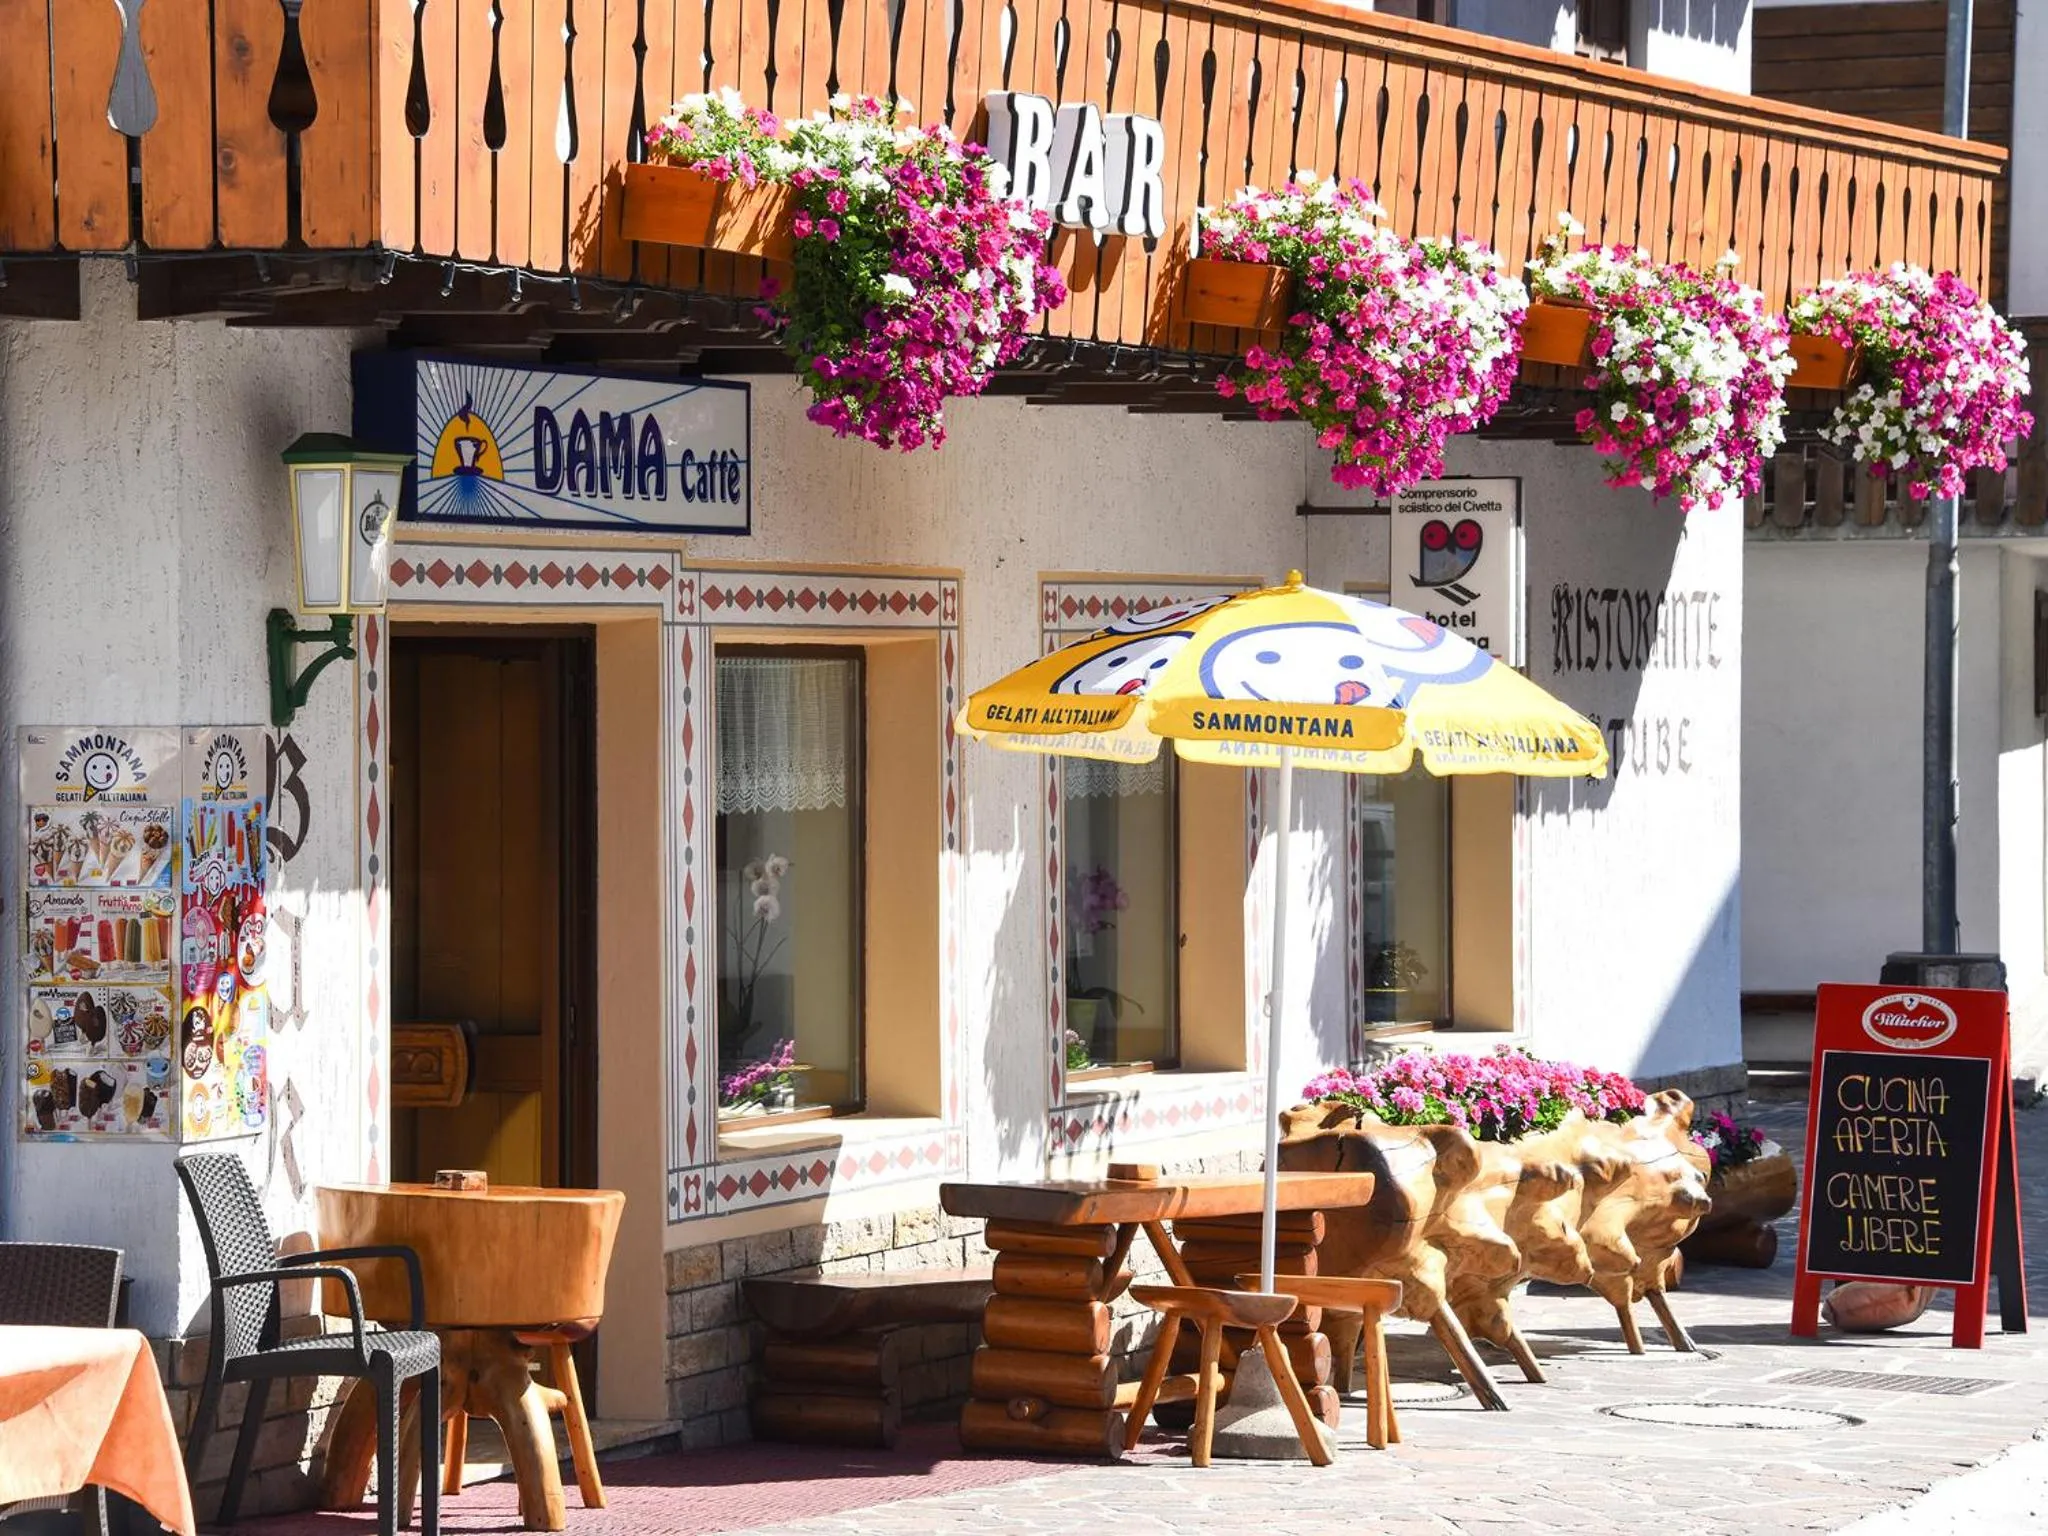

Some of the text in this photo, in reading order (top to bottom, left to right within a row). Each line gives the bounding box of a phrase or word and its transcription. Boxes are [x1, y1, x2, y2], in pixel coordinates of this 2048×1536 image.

[986, 90, 1167, 239] BAR
[534, 405, 740, 504] DAMA Caffè
[1398, 500, 1502, 513] sciistico del Civetta
[1399, 487, 1477, 500] Comprensorio
[1425, 612, 1476, 628] hotel
[1551, 582, 1721, 676] RISTORANTE
[986, 704, 1038, 724] GELATI
[1193, 711, 1355, 738] SAMMONTANA
[56, 734, 147, 782] SAMMONTANA
[202, 734, 247, 781] SAMMONTANA
[1584, 713, 1693, 785] TUBE
[55, 792, 82, 802] GELATI
[1837, 1075, 1950, 1115] CUCINA
[1832, 1116, 1947, 1157] APERTA
[1827, 1172, 1940, 1215] CAMERE
[1840, 1215, 1940, 1255] LIBERE
